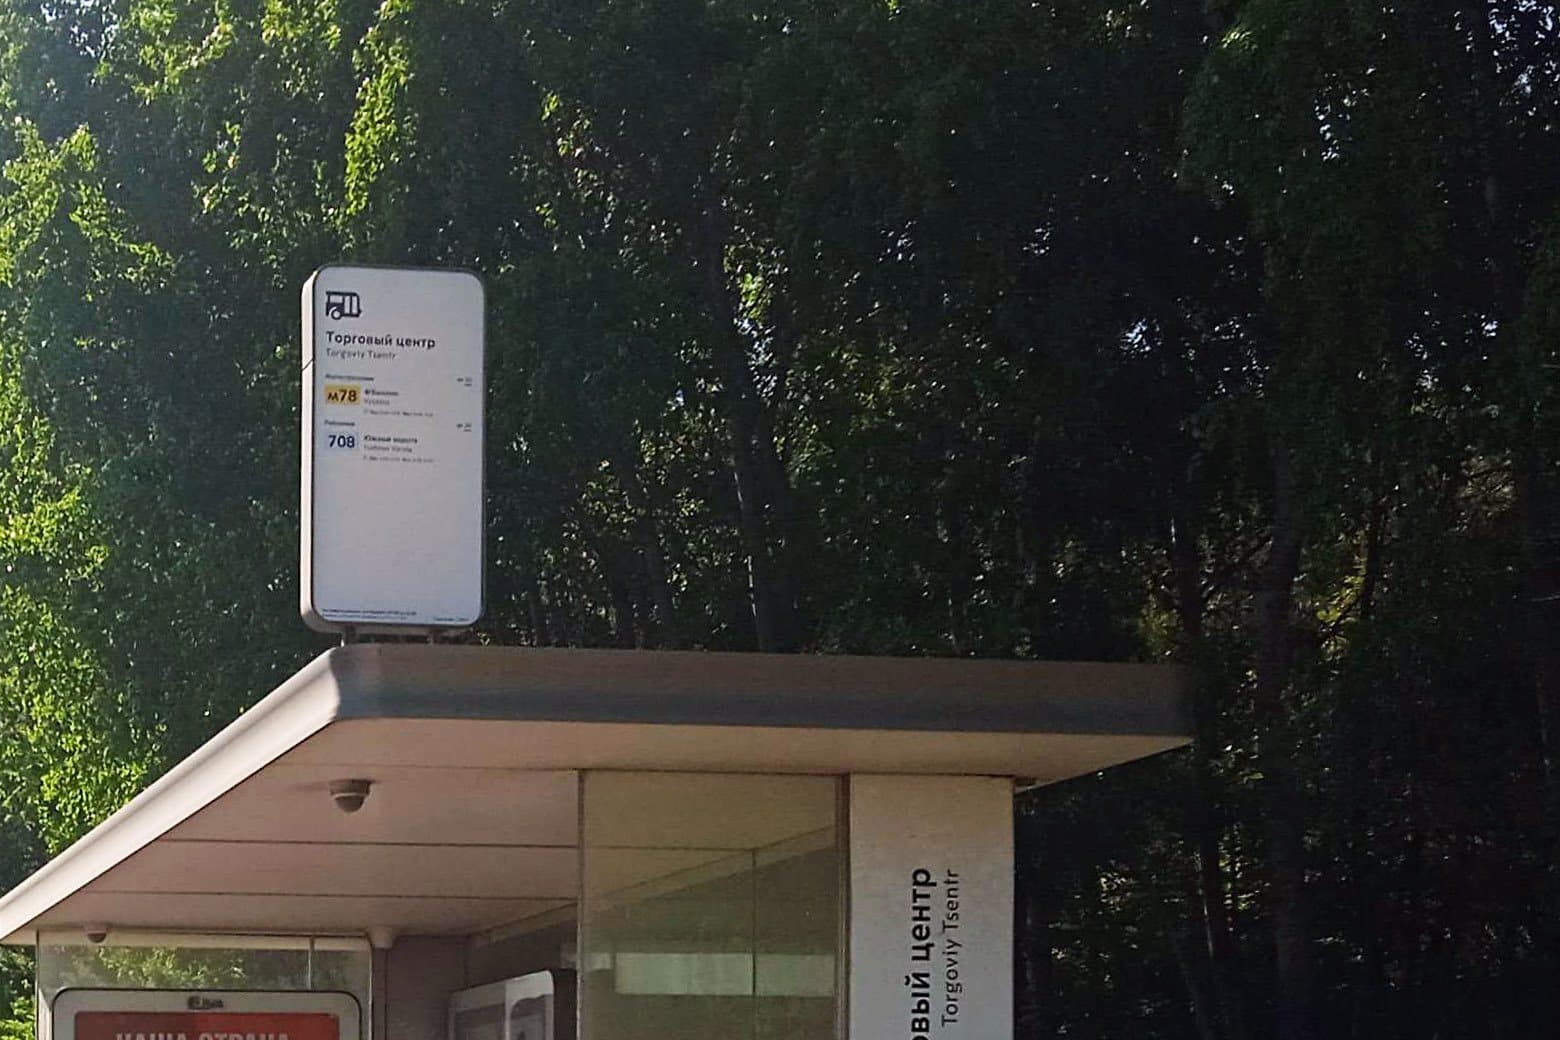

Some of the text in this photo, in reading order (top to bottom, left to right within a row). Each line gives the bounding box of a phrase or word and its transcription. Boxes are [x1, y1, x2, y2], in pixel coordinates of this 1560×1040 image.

[326, 331, 436, 350] Торговый центр
[328, 435, 356, 449] 708
[912, 868, 937, 962] центр
[942, 869, 963, 1027] Torgoviy Tsentr
